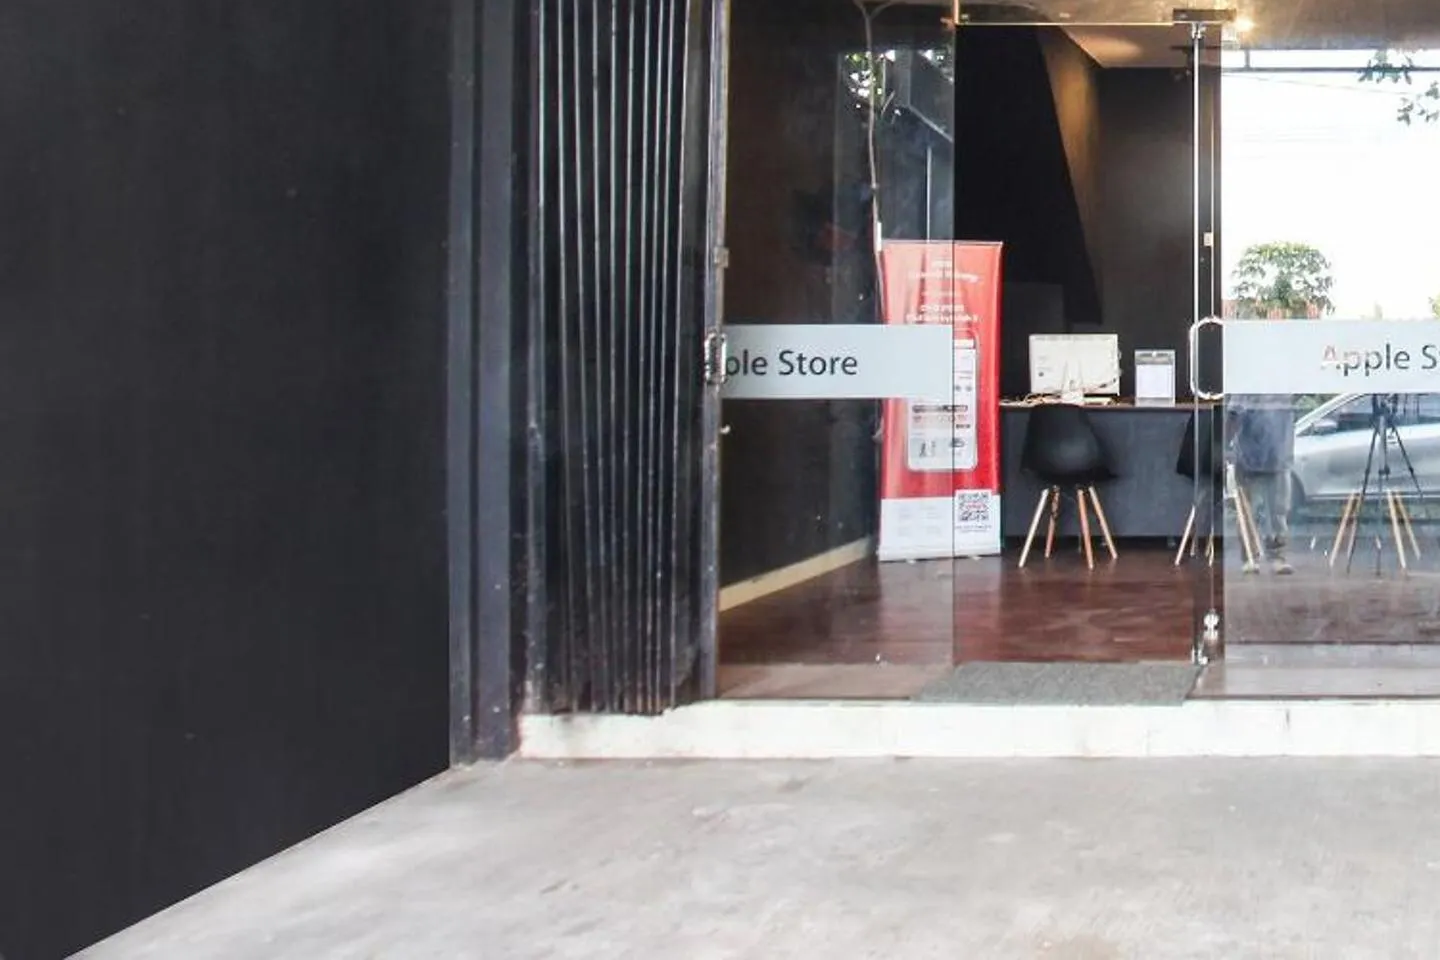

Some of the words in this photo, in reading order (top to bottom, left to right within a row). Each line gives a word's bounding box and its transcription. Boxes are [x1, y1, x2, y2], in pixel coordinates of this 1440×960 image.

[725, 349, 768, 376] ple
[778, 349, 858, 376] Store
[1320, 343, 1411, 377] Apple
